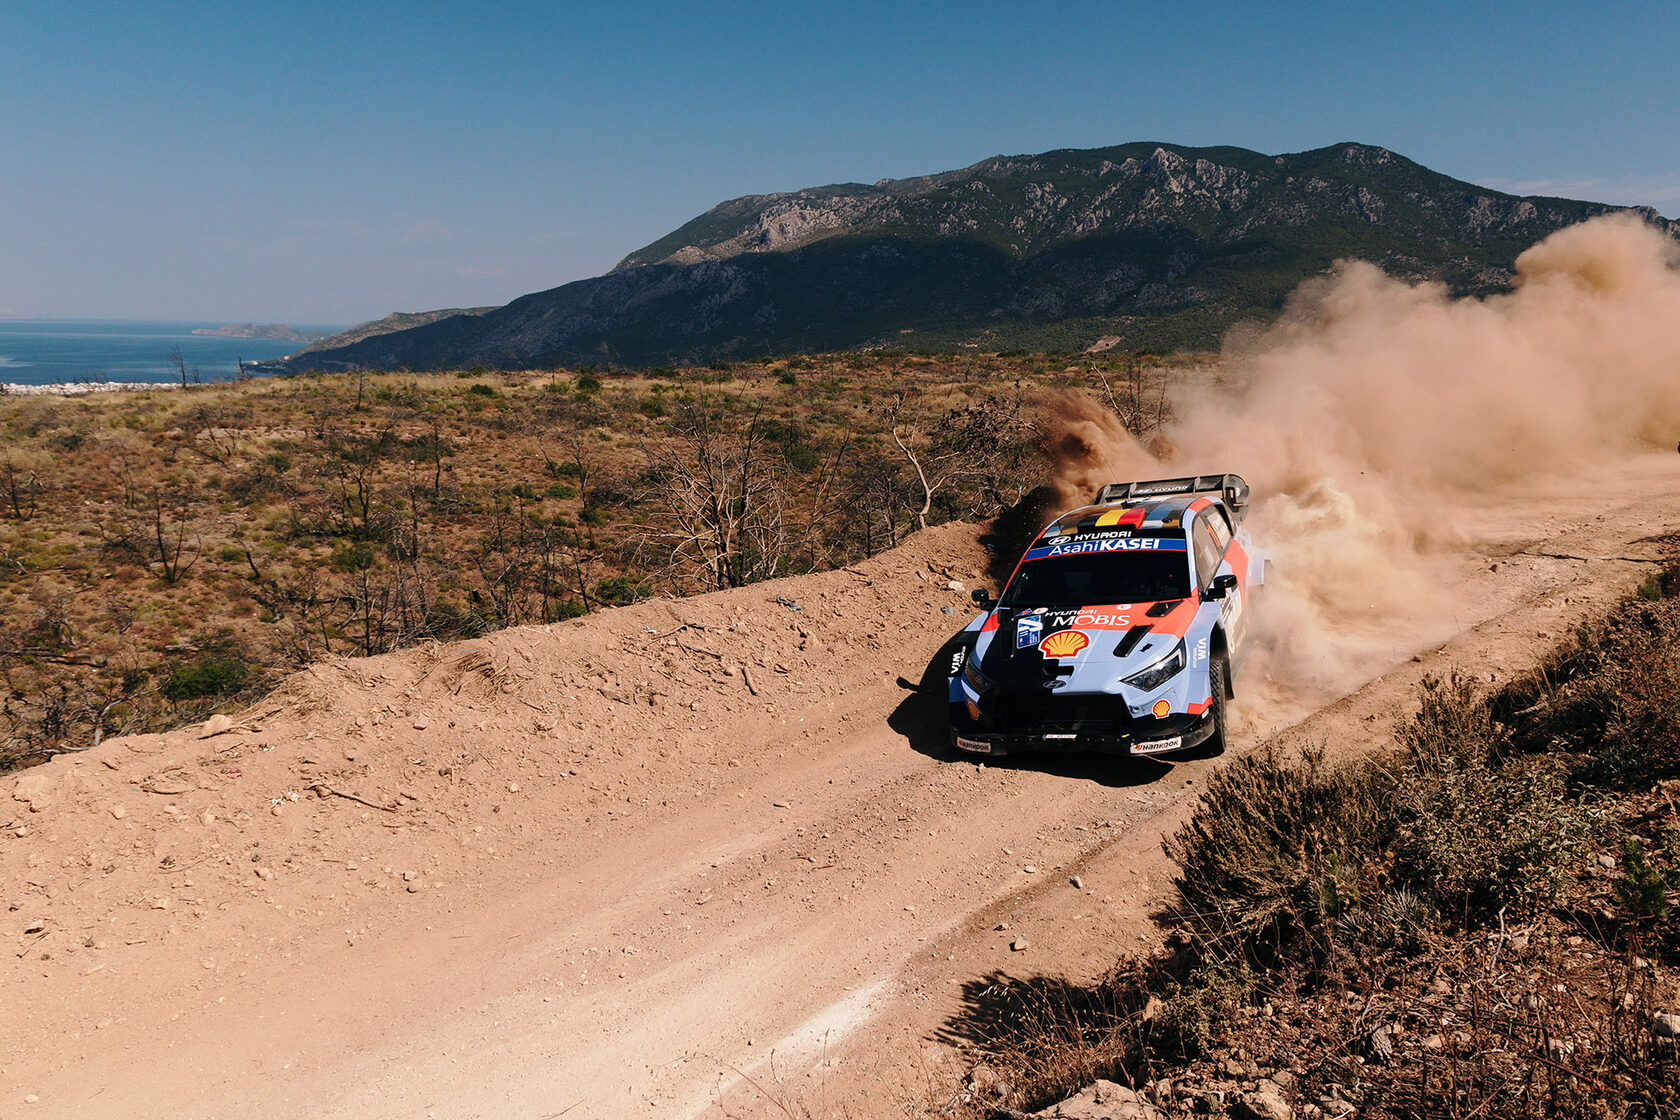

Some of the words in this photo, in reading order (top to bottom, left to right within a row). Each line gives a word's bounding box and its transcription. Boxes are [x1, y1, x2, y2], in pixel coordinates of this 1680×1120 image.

[1074, 531, 1132, 541] HYUNDAI
[1044, 609, 1098, 617] HYUNDAI
[1051, 614, 1131, 627] MOBIS
